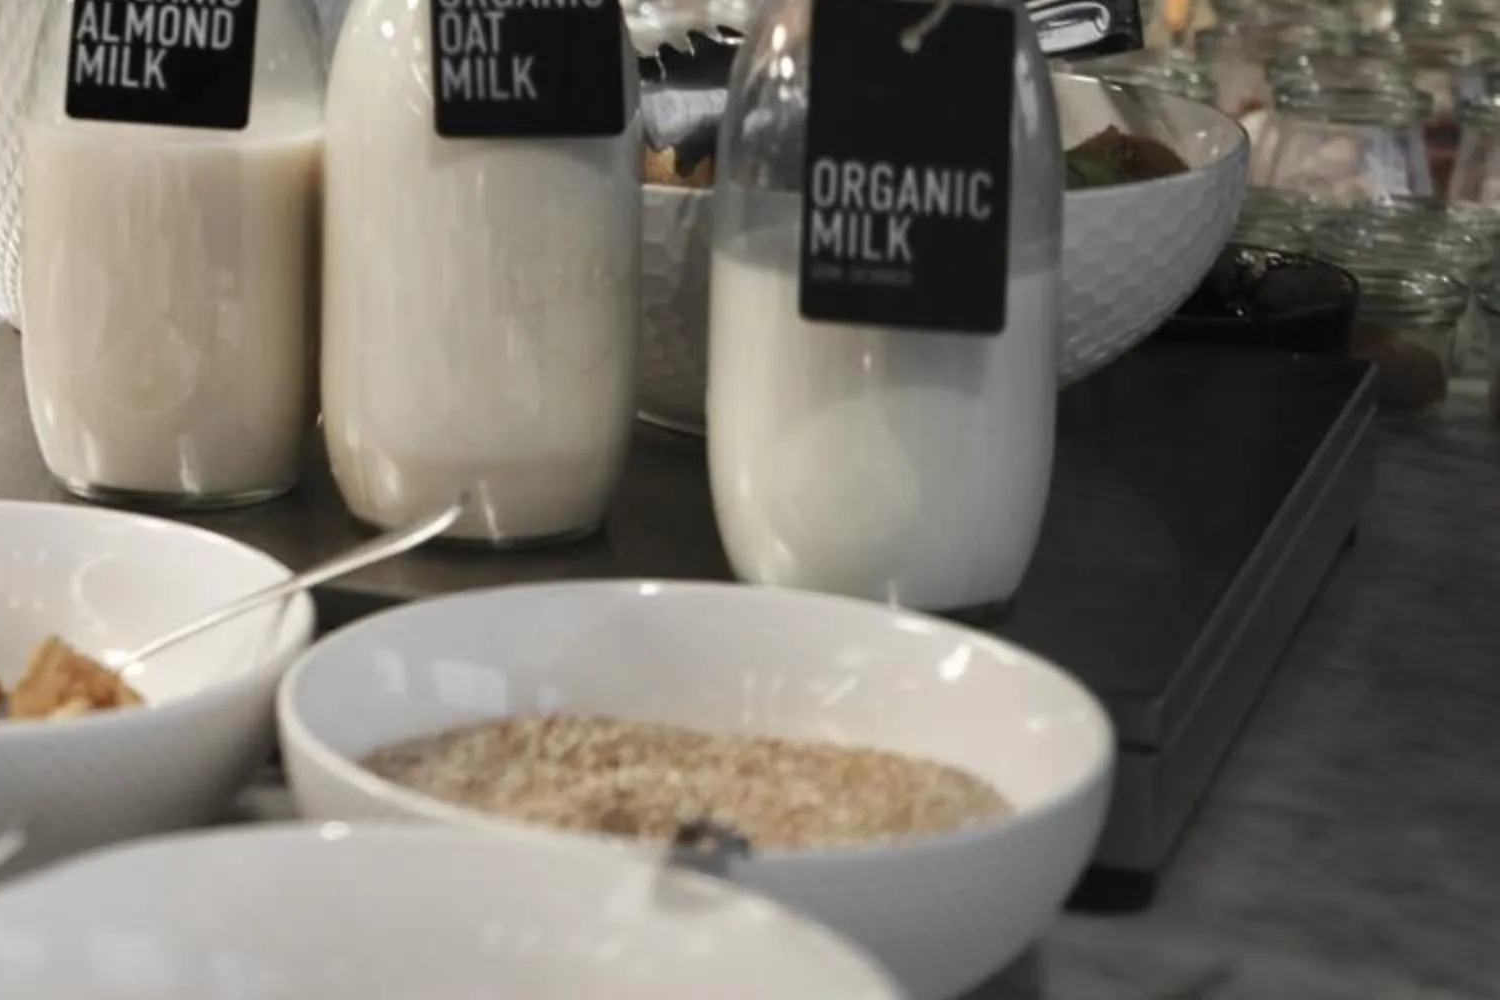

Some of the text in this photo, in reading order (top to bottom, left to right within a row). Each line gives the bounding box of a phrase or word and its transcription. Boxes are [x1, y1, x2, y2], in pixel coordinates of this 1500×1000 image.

[76, 1, 234, 50] ALMOND
[439, 10, 505, 56] OAT
[74, 44, 167, 90] MILK
[440, 54, 537, 102] MILK
[811, 157, 993, 220] ORGANIC
[810, 208, 913, 262] MILK
